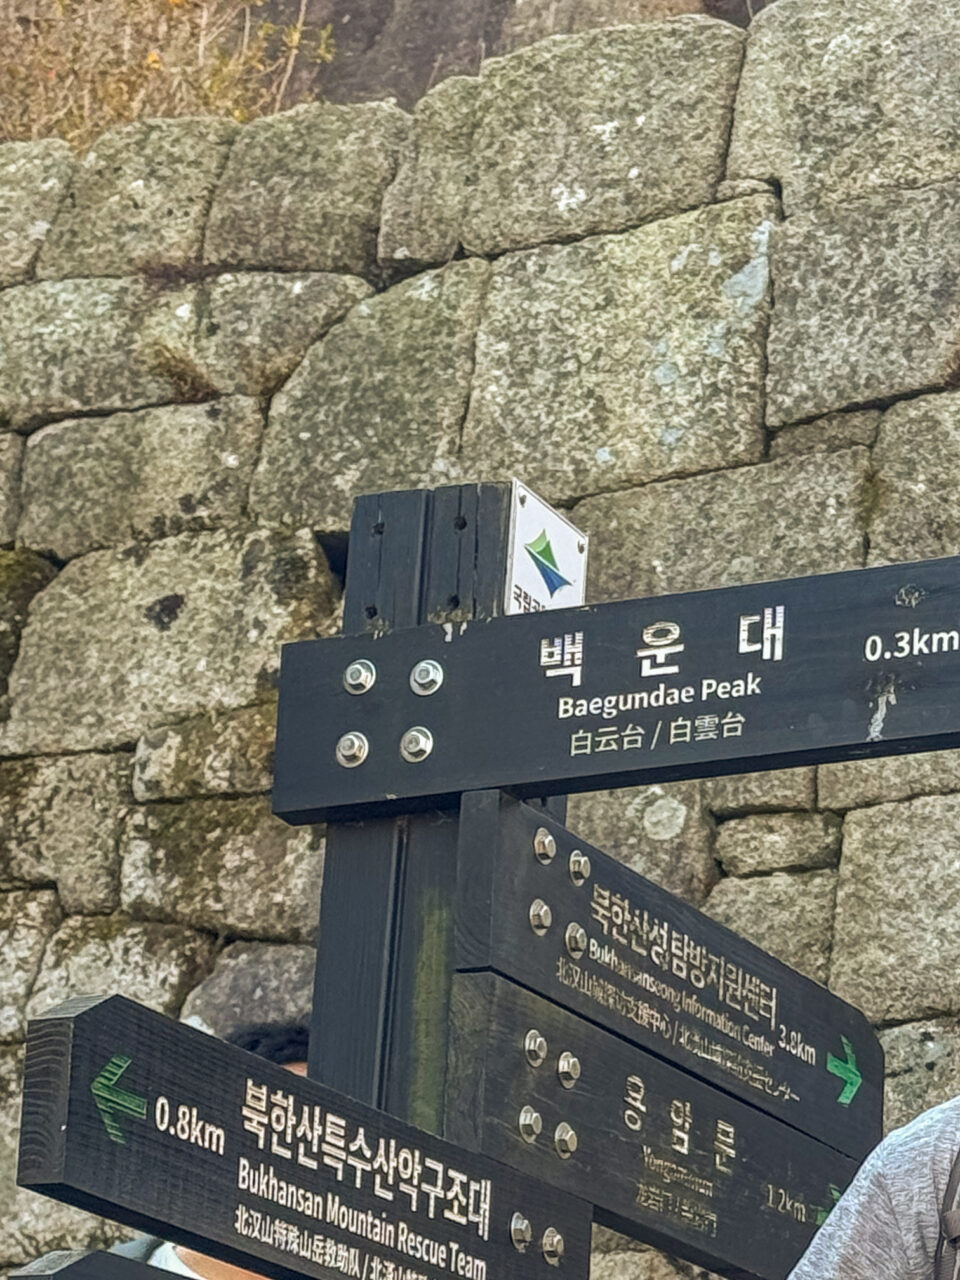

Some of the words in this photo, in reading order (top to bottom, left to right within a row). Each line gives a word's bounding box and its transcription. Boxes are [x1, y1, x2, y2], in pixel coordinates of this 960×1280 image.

[864, 627, 960, 662] 0.3km
[558, 682, 695, 719] Baegundae
[701, 671, 762, 702] Peak
[570, 723, 646, 757] 白云台
[778, 1024, 817, 1067] 3.8km
[155, 1096, 226, 1155] 0.8km
[241, 1078, 492, 1241] 북한산특수산악구조대
[237, 1156, 323, 1220] Bukhansan
[326, 1191, 395, 1248] Mountain
[398, 1220, 447, 1268] Rescue
